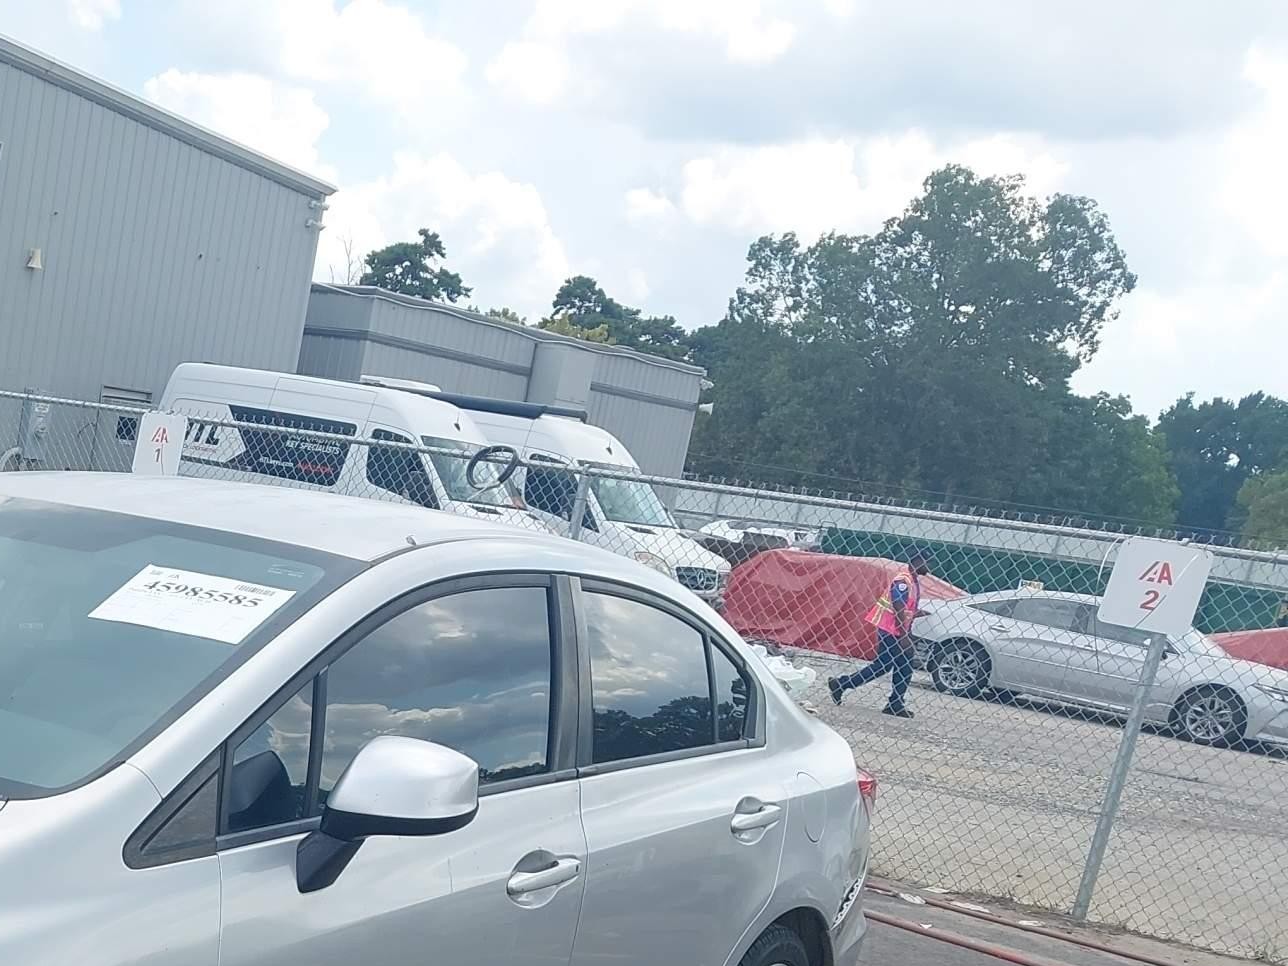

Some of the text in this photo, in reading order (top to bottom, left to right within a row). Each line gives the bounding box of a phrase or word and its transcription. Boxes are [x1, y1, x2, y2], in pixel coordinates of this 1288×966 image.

[299, 442, 341, 455] SPECIALISTS
[143, 580, 263, 608] 45985585
[1139, 590, 1160, 611] 2
